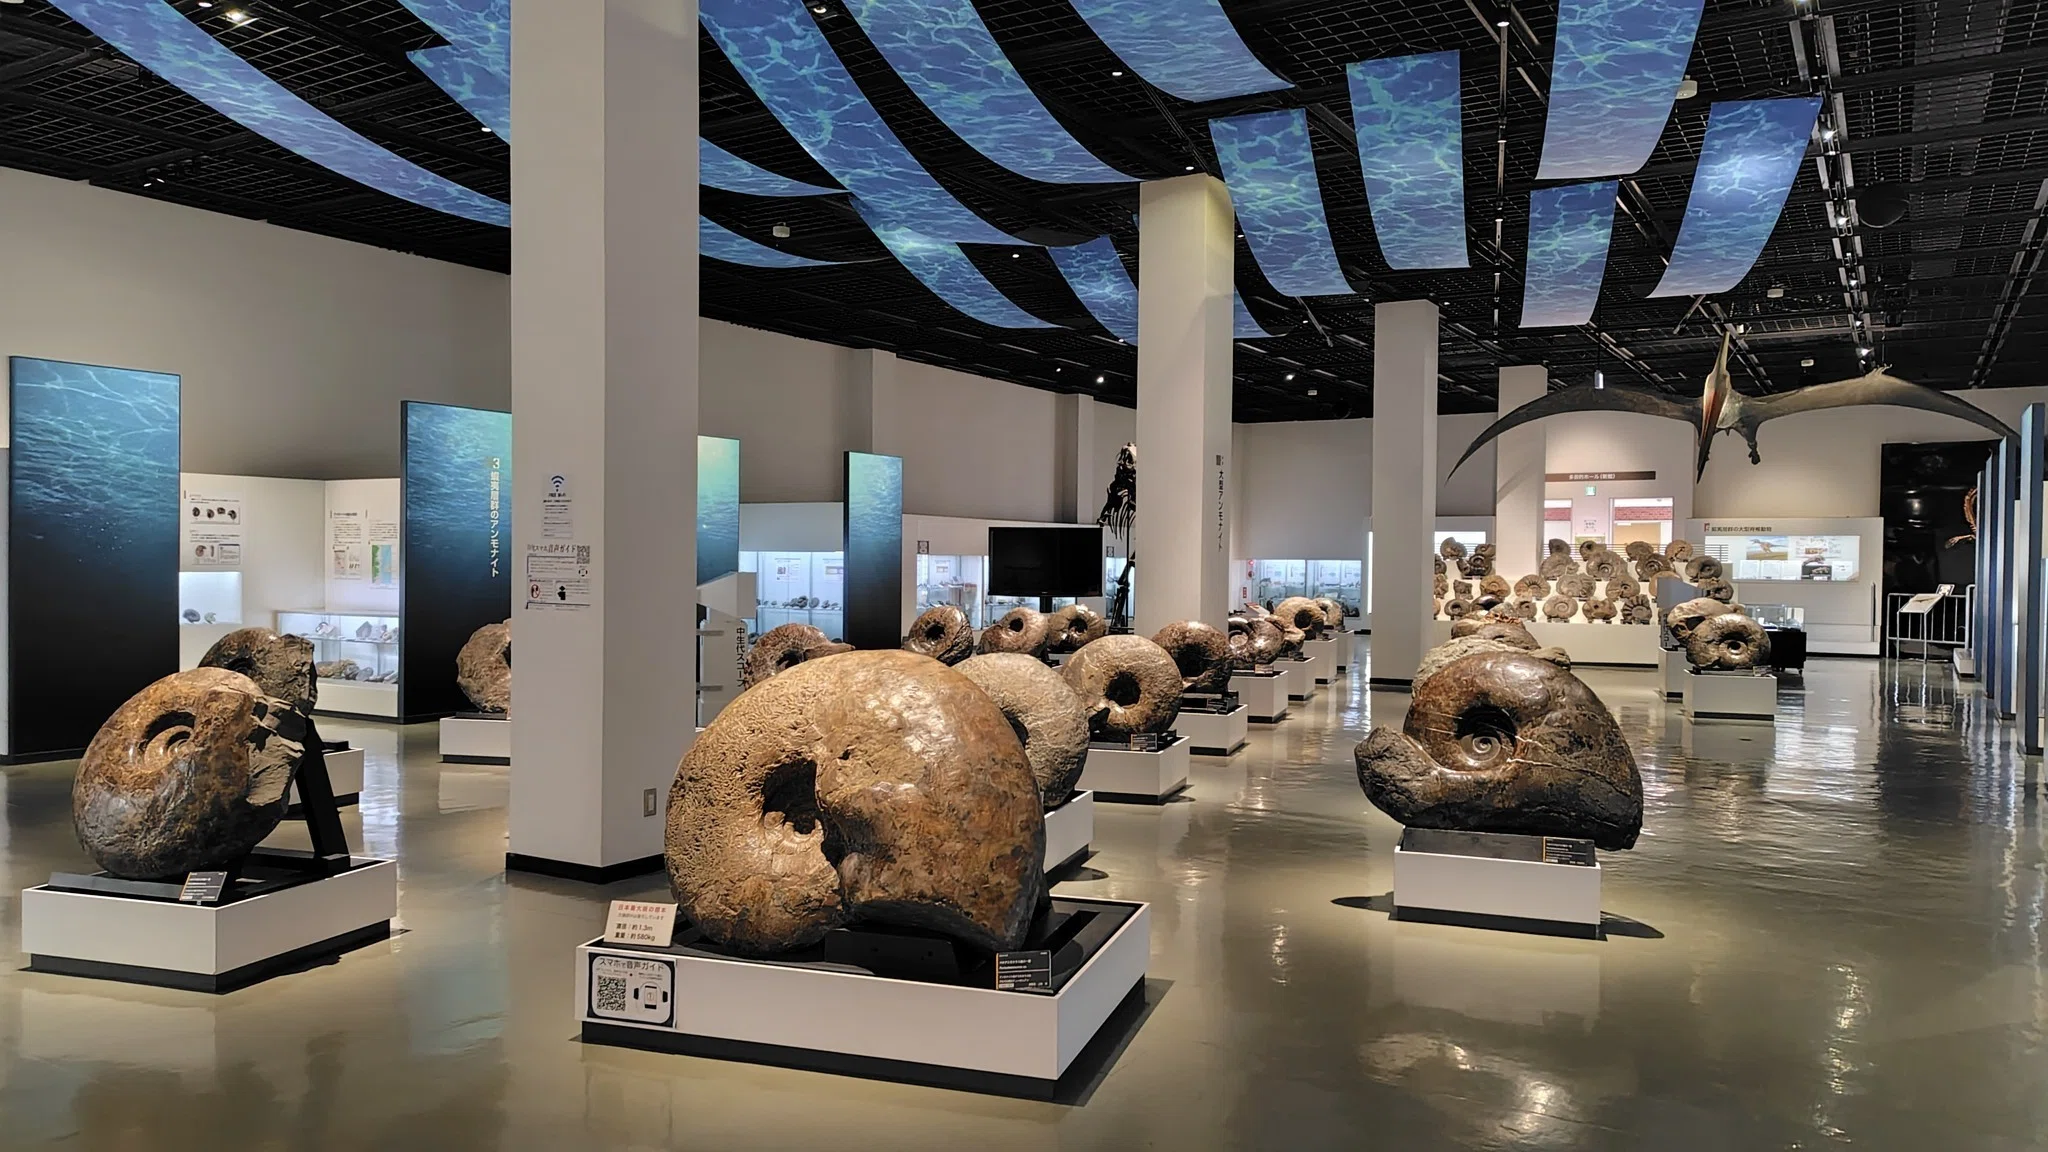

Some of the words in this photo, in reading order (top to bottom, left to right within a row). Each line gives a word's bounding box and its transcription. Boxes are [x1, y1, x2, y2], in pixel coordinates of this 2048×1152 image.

[492, 458, 500, 469] 3
[599, 957, 665, 971] スマホで音声ガイド
